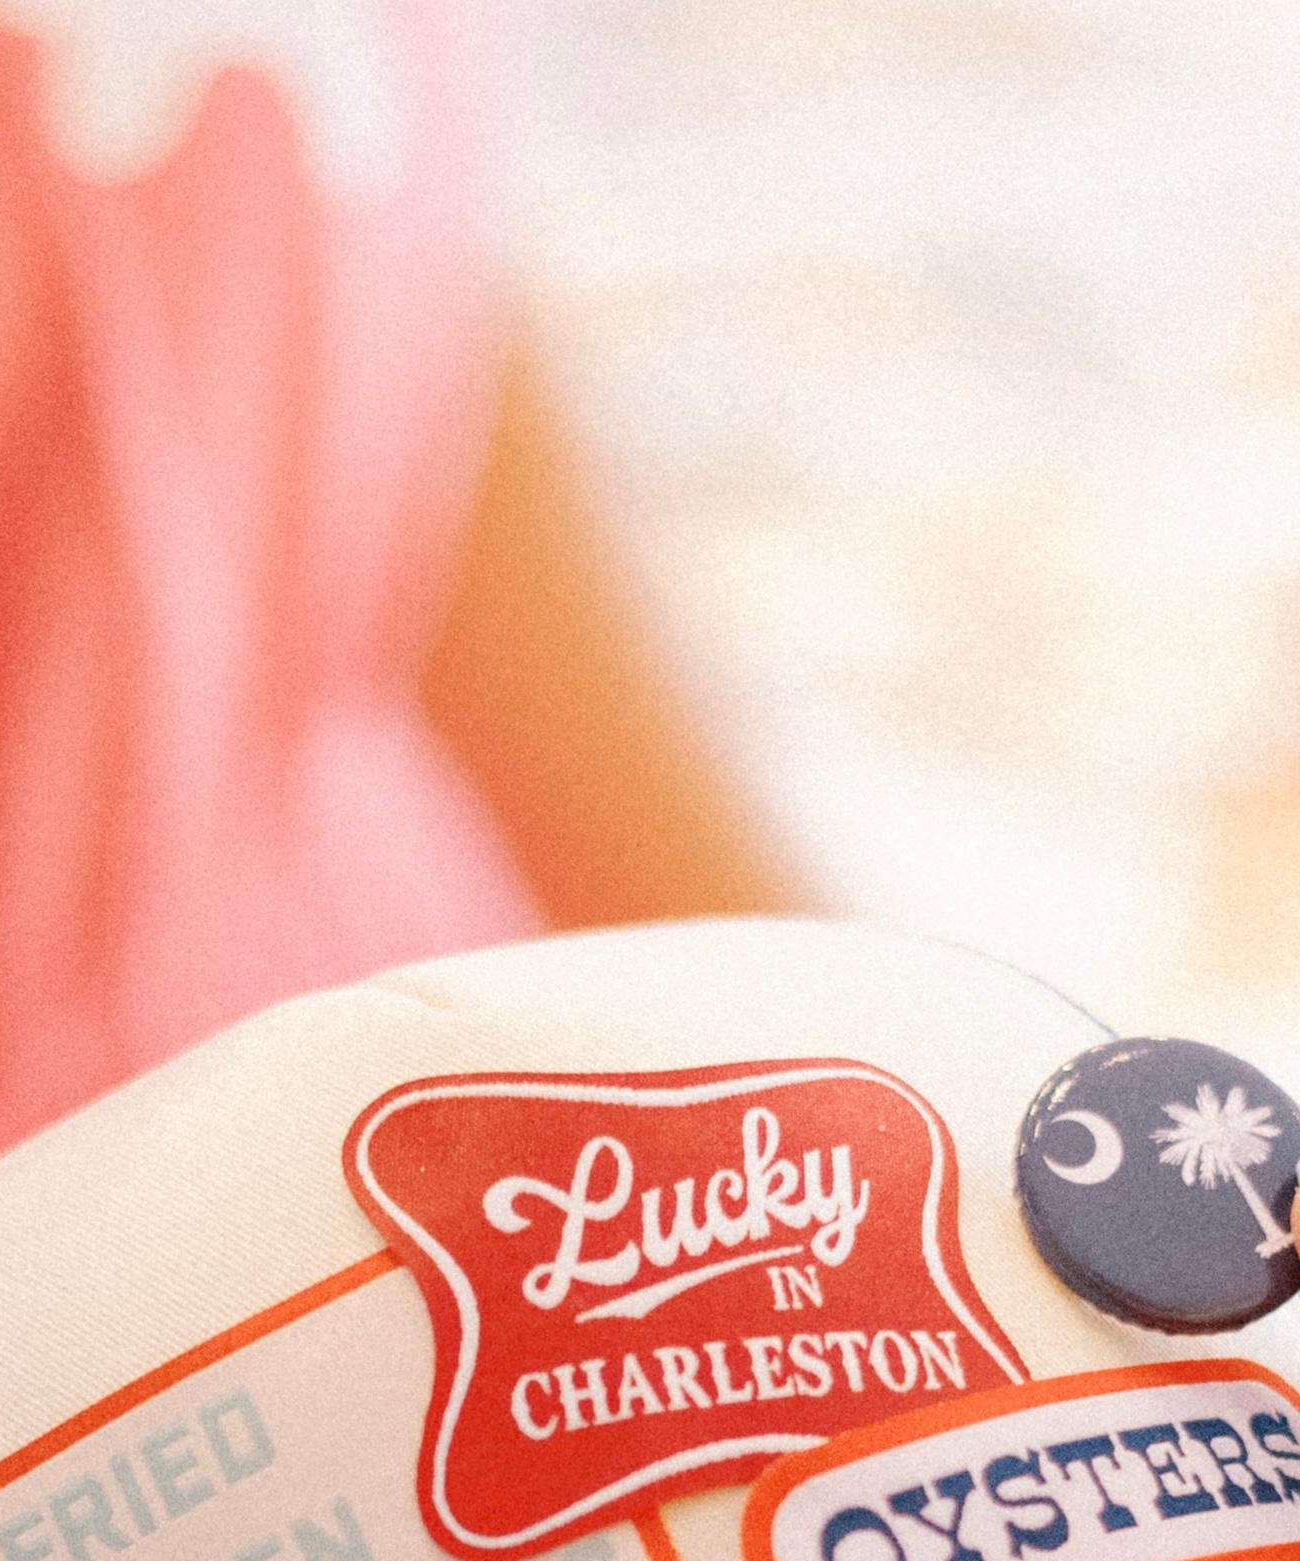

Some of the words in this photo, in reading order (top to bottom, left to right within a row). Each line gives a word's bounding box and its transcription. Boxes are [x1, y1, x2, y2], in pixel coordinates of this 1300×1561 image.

[483, 1106, 869, 1310] Lucky
[771, 1264, 822, 1312] IN
[510, 1329, 967, 1441] CHARLESTON
